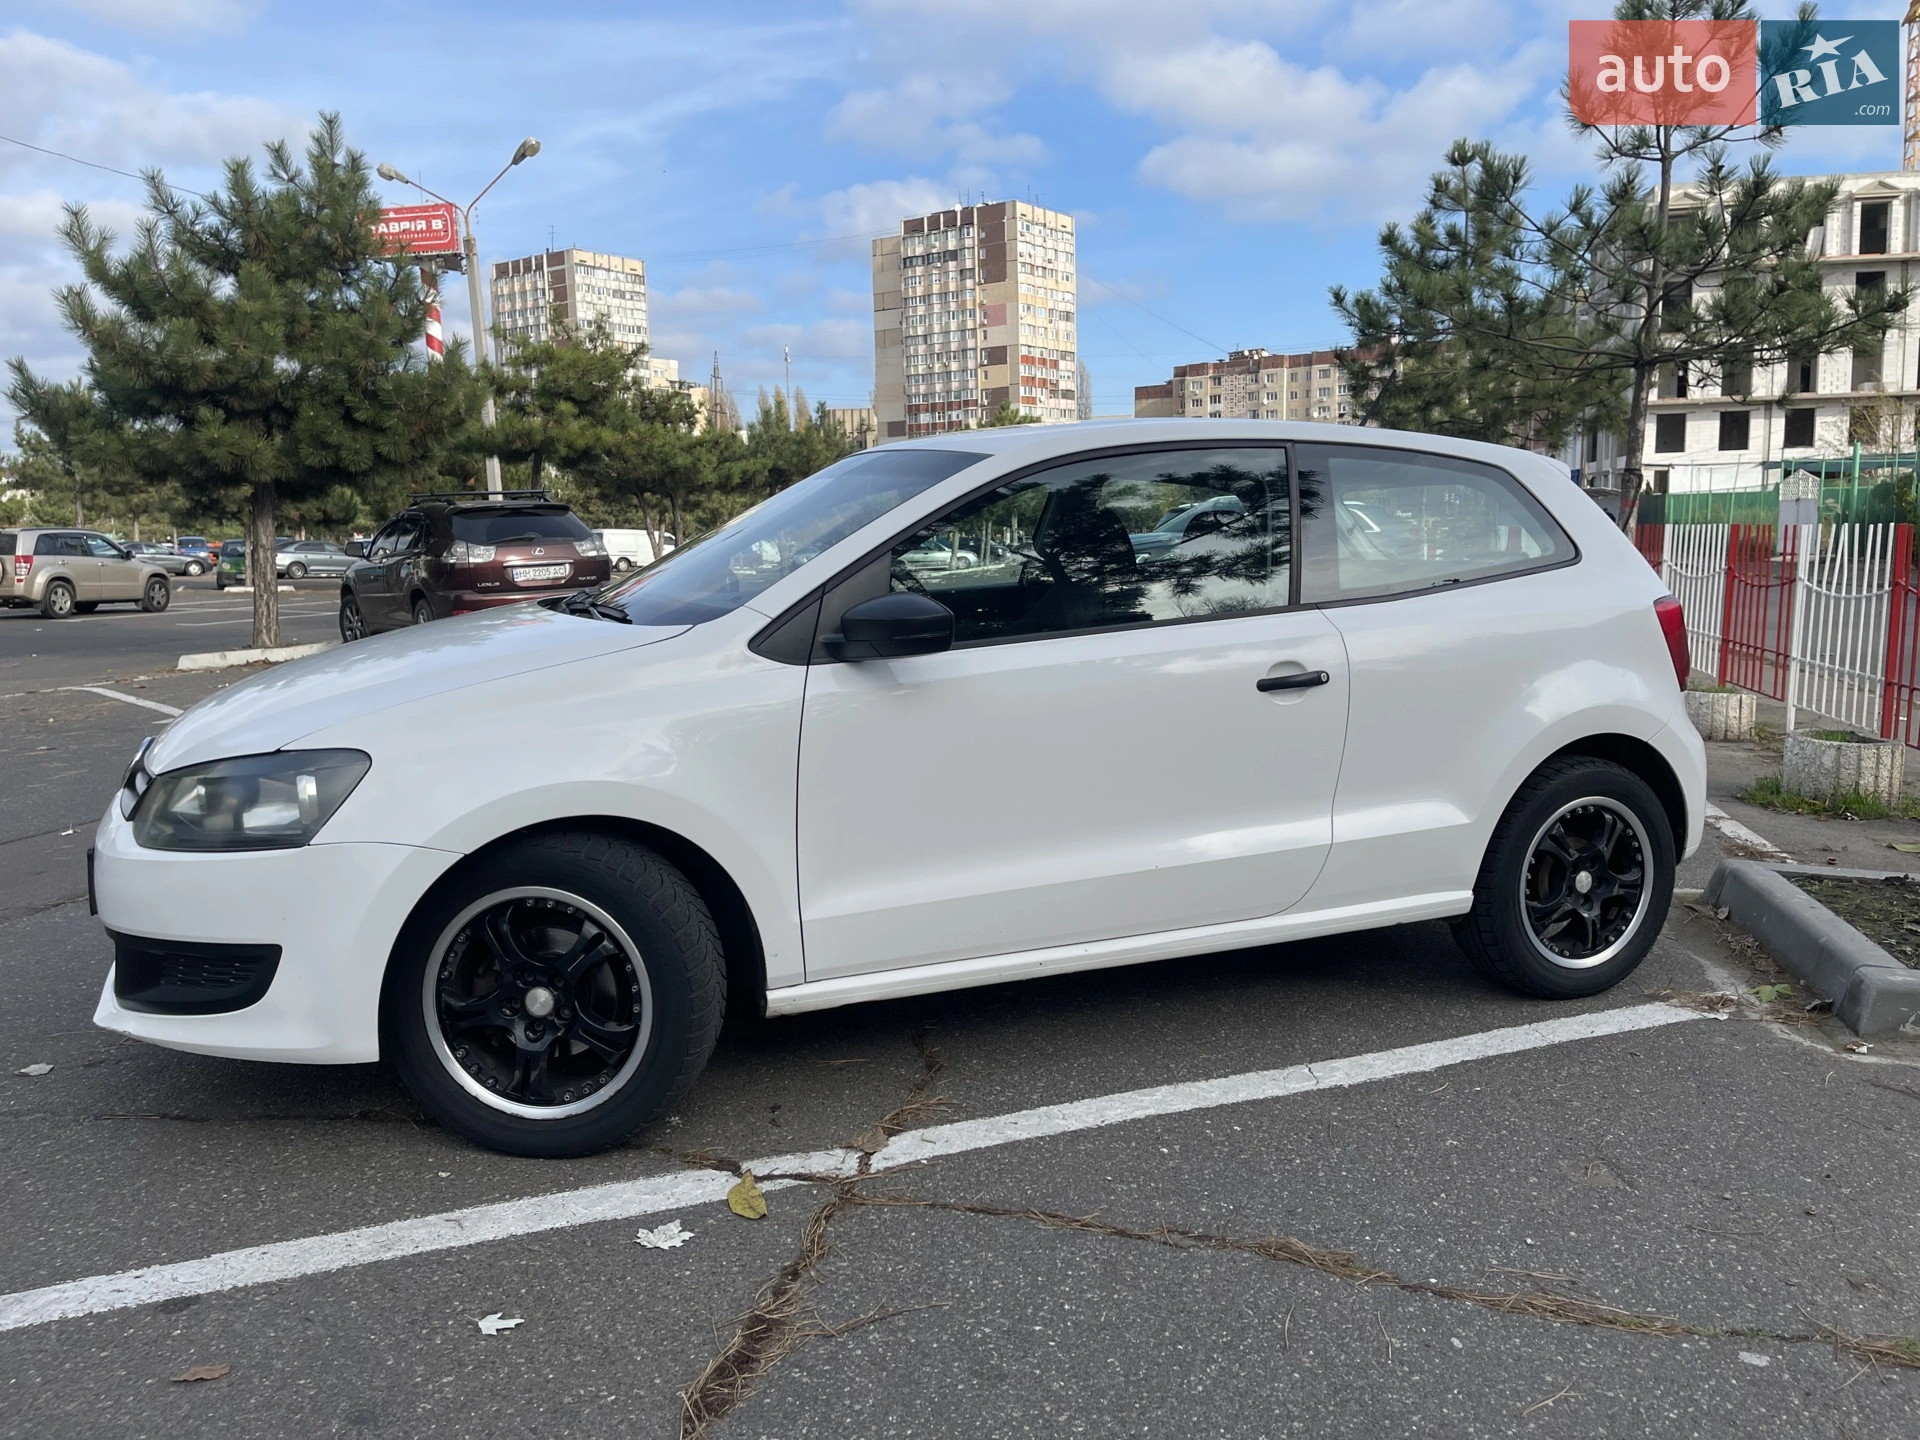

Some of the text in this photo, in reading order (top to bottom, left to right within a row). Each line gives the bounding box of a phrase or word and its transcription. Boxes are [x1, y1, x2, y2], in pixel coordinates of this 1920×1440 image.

[431, 219, 443, 230] В
[532, 568, 551, 577] 2205
[553, 567, 565, 576] AC
